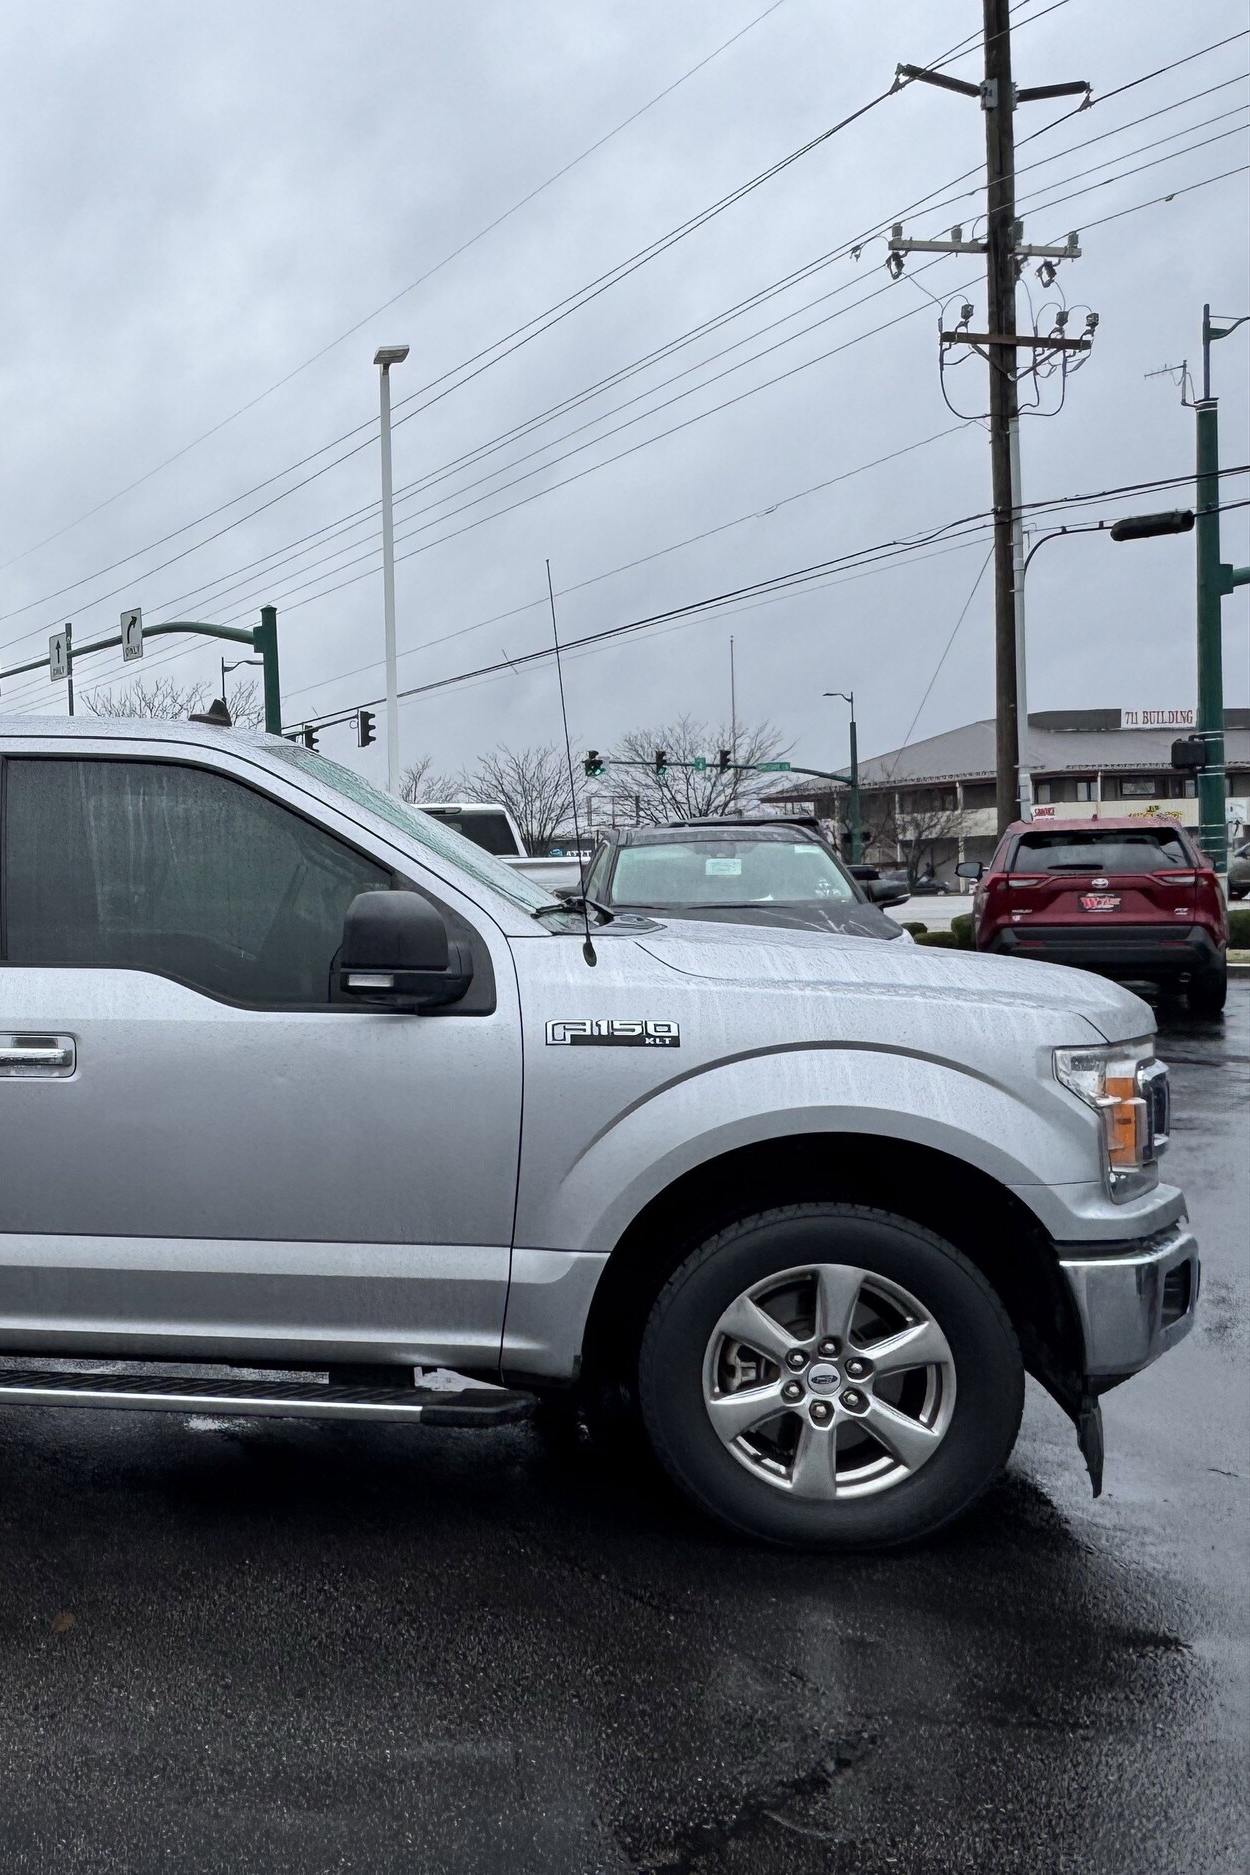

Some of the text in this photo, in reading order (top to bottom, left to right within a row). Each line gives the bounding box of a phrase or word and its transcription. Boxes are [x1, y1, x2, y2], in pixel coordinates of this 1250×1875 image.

[1125, 710, 1193, 725] 711 BUILDING
[644, 1037, 672, 1045] XLT
